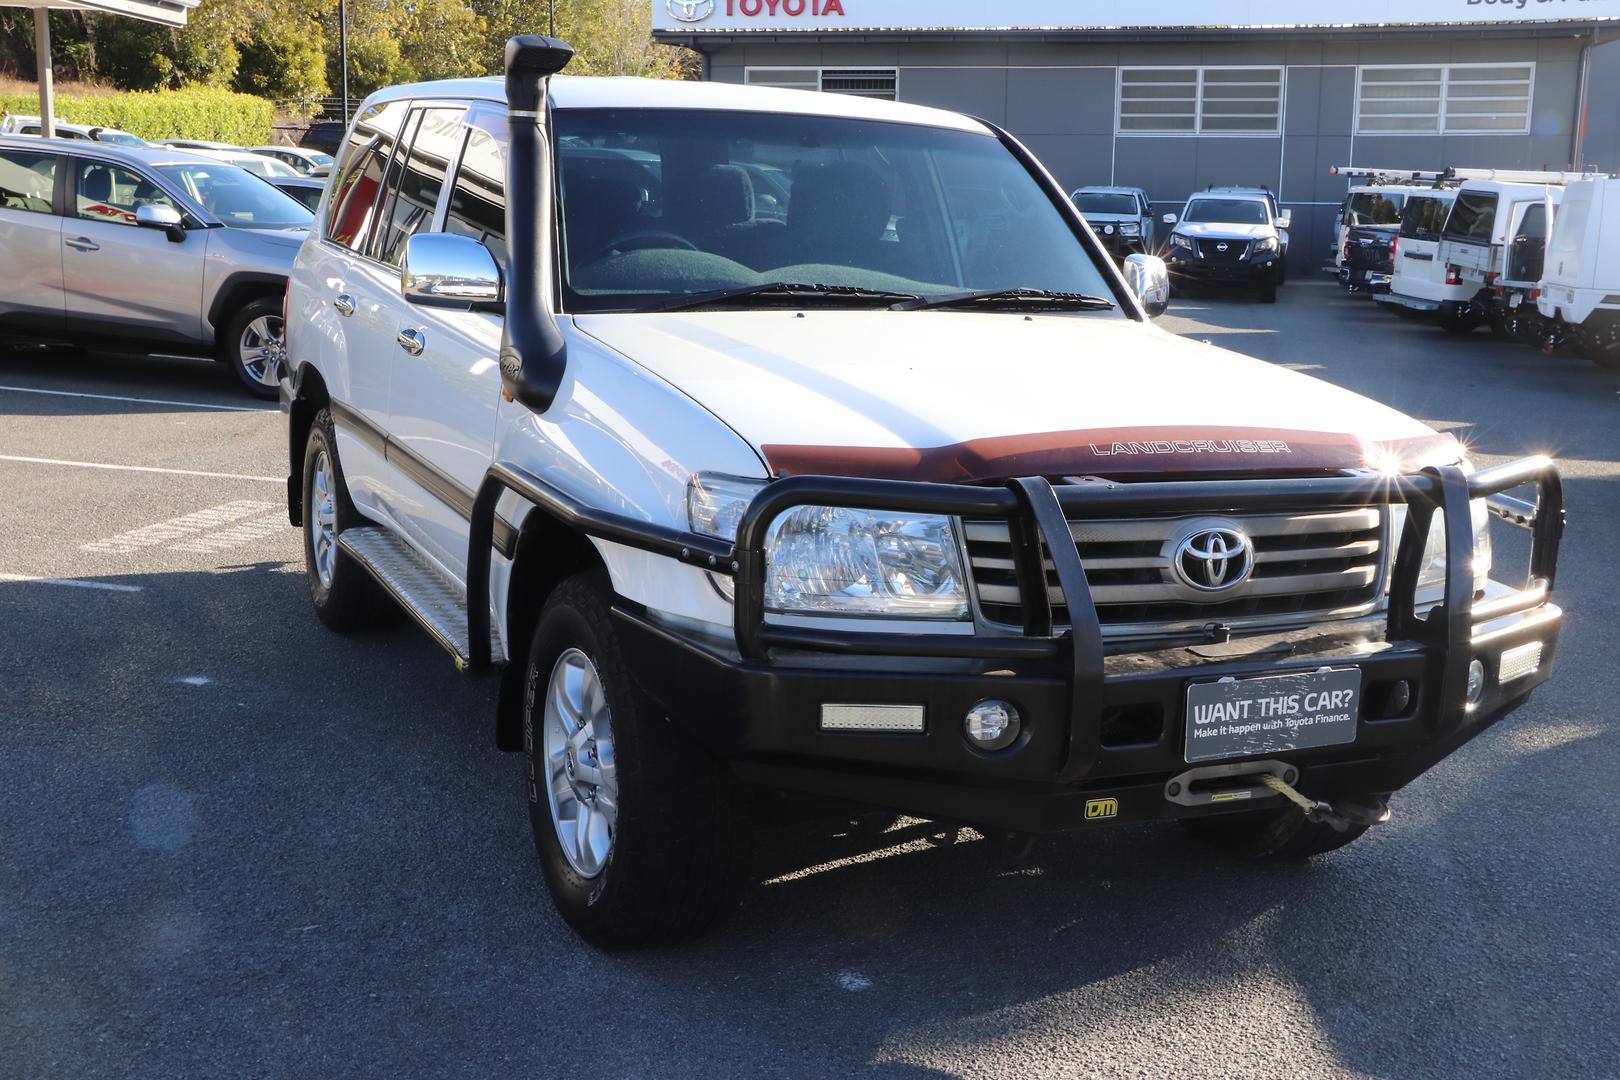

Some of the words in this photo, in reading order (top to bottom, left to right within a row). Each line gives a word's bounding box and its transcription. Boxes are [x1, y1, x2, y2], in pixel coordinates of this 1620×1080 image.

[1089, 439, 1292, 456] LANDCRUISER
[1194, 700, 1252, 725] WANT
[1257, 695, 1300, 717] THIS
[1304, 689, 1354, 712] CAR?
[1194, 726, 1218, 738] Make
[1219, 725, 1227, 735] it
[1228, 722, 1261, 736] happen
[1263, 719, 1283, 730] with
[1284, 716, 1314, 729] Toyota
[1315, 713, 1351, 724] Finance.
